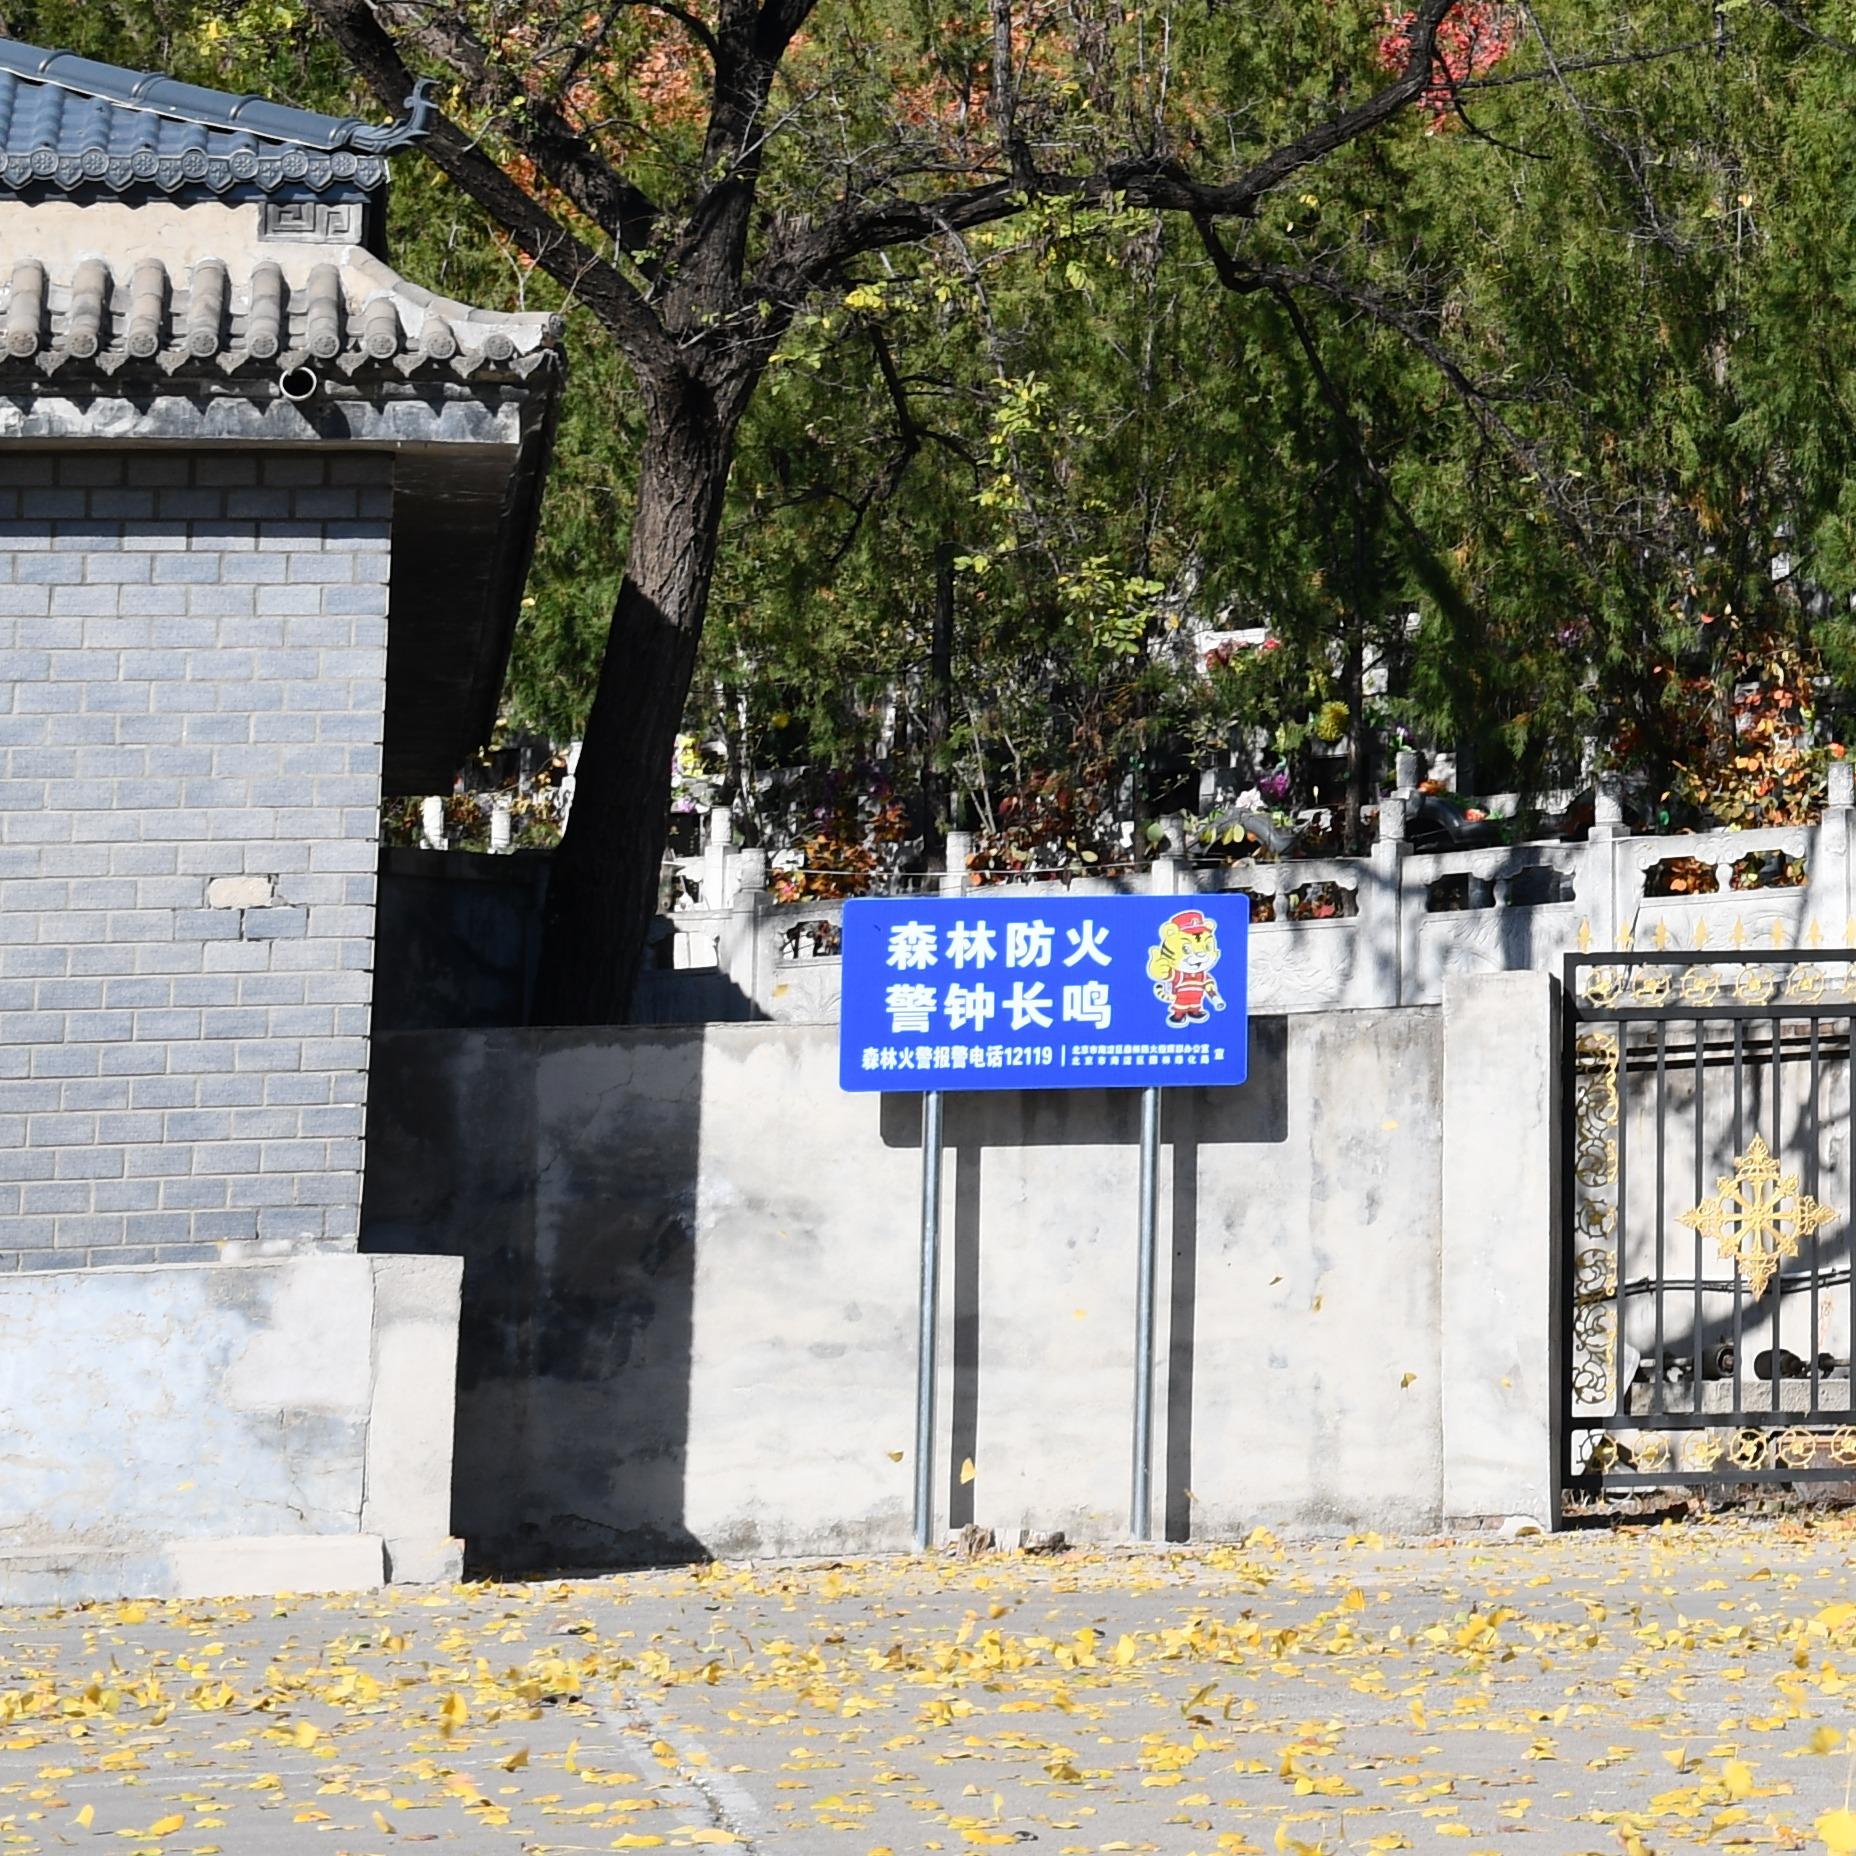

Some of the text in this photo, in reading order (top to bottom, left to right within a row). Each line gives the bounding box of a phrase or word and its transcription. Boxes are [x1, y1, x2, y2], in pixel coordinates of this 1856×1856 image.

[885, 919, 1113, 971] 森林防火
[884, 980, 1113, 1034] 警钟长鸣
[861, 1044, 1053, 1071] 森林火警报警电话12119
